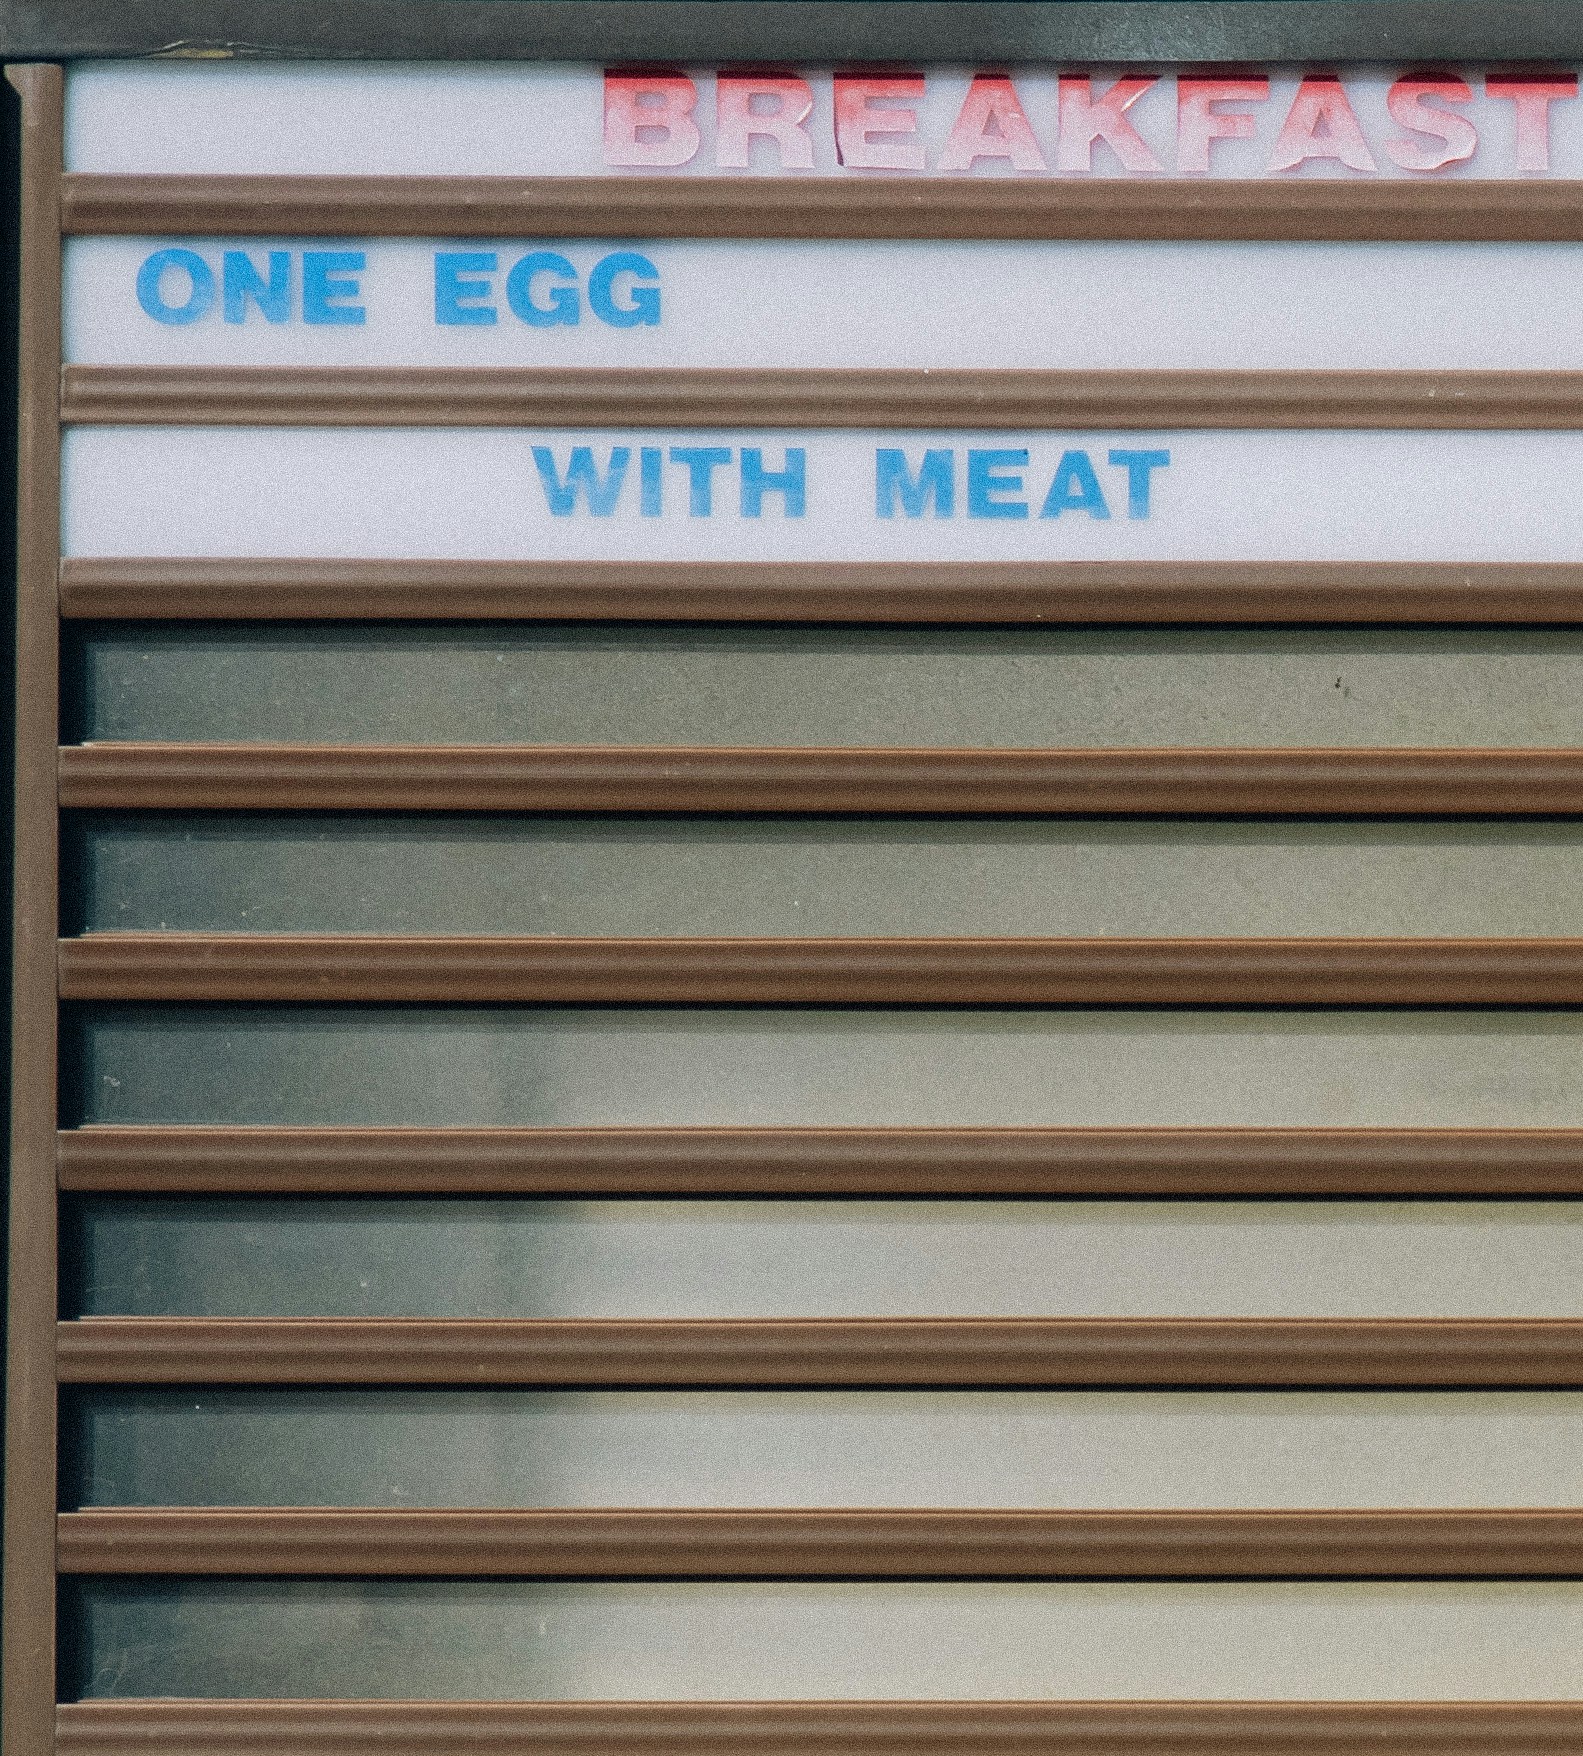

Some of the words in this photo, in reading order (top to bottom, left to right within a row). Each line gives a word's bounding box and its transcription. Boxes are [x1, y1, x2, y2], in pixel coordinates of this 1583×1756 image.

[603, 68, 1579, 173] BREAKFAST
[135, 247, 369, 327] ONE
[432, 250, 663, 330] EGG
[531, 445, 807, 519] WITH
[875, 447, 1172, 521] MEAT
